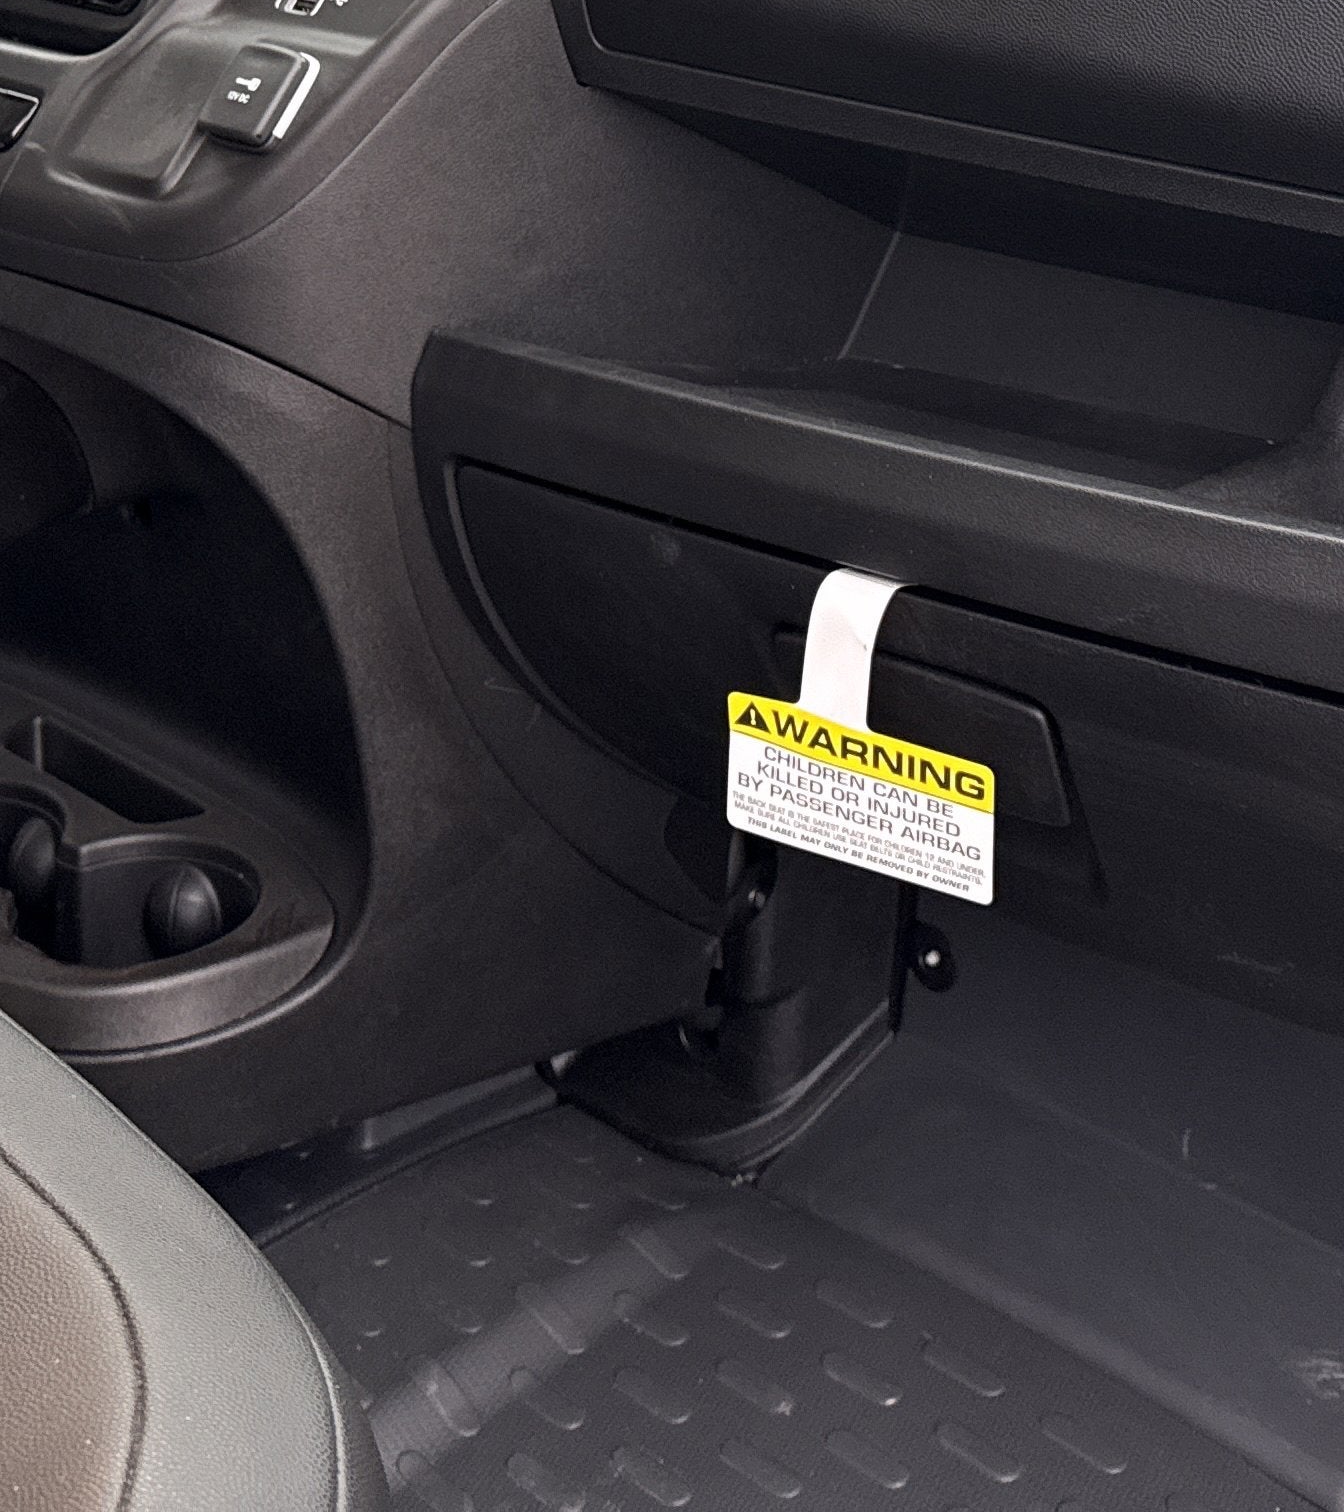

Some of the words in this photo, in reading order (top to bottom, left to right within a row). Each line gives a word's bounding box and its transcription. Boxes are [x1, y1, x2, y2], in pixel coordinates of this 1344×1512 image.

[764, 744, 864, 791] CHILDREN
[873, 780, 917, 807] CAN
[927, 797, 953, 818] BE
[772, 709, 984, 802] WARNING
[738, 771, 762, 793] BY
[770, 783, 892, 834] PASSENGER
[900, 825, 980, 861] AIRBAG
[758, 761, 822, 795] KILLED
[831, 786, 858, 806] OR
[868, 797, 960, 838] INJURED
